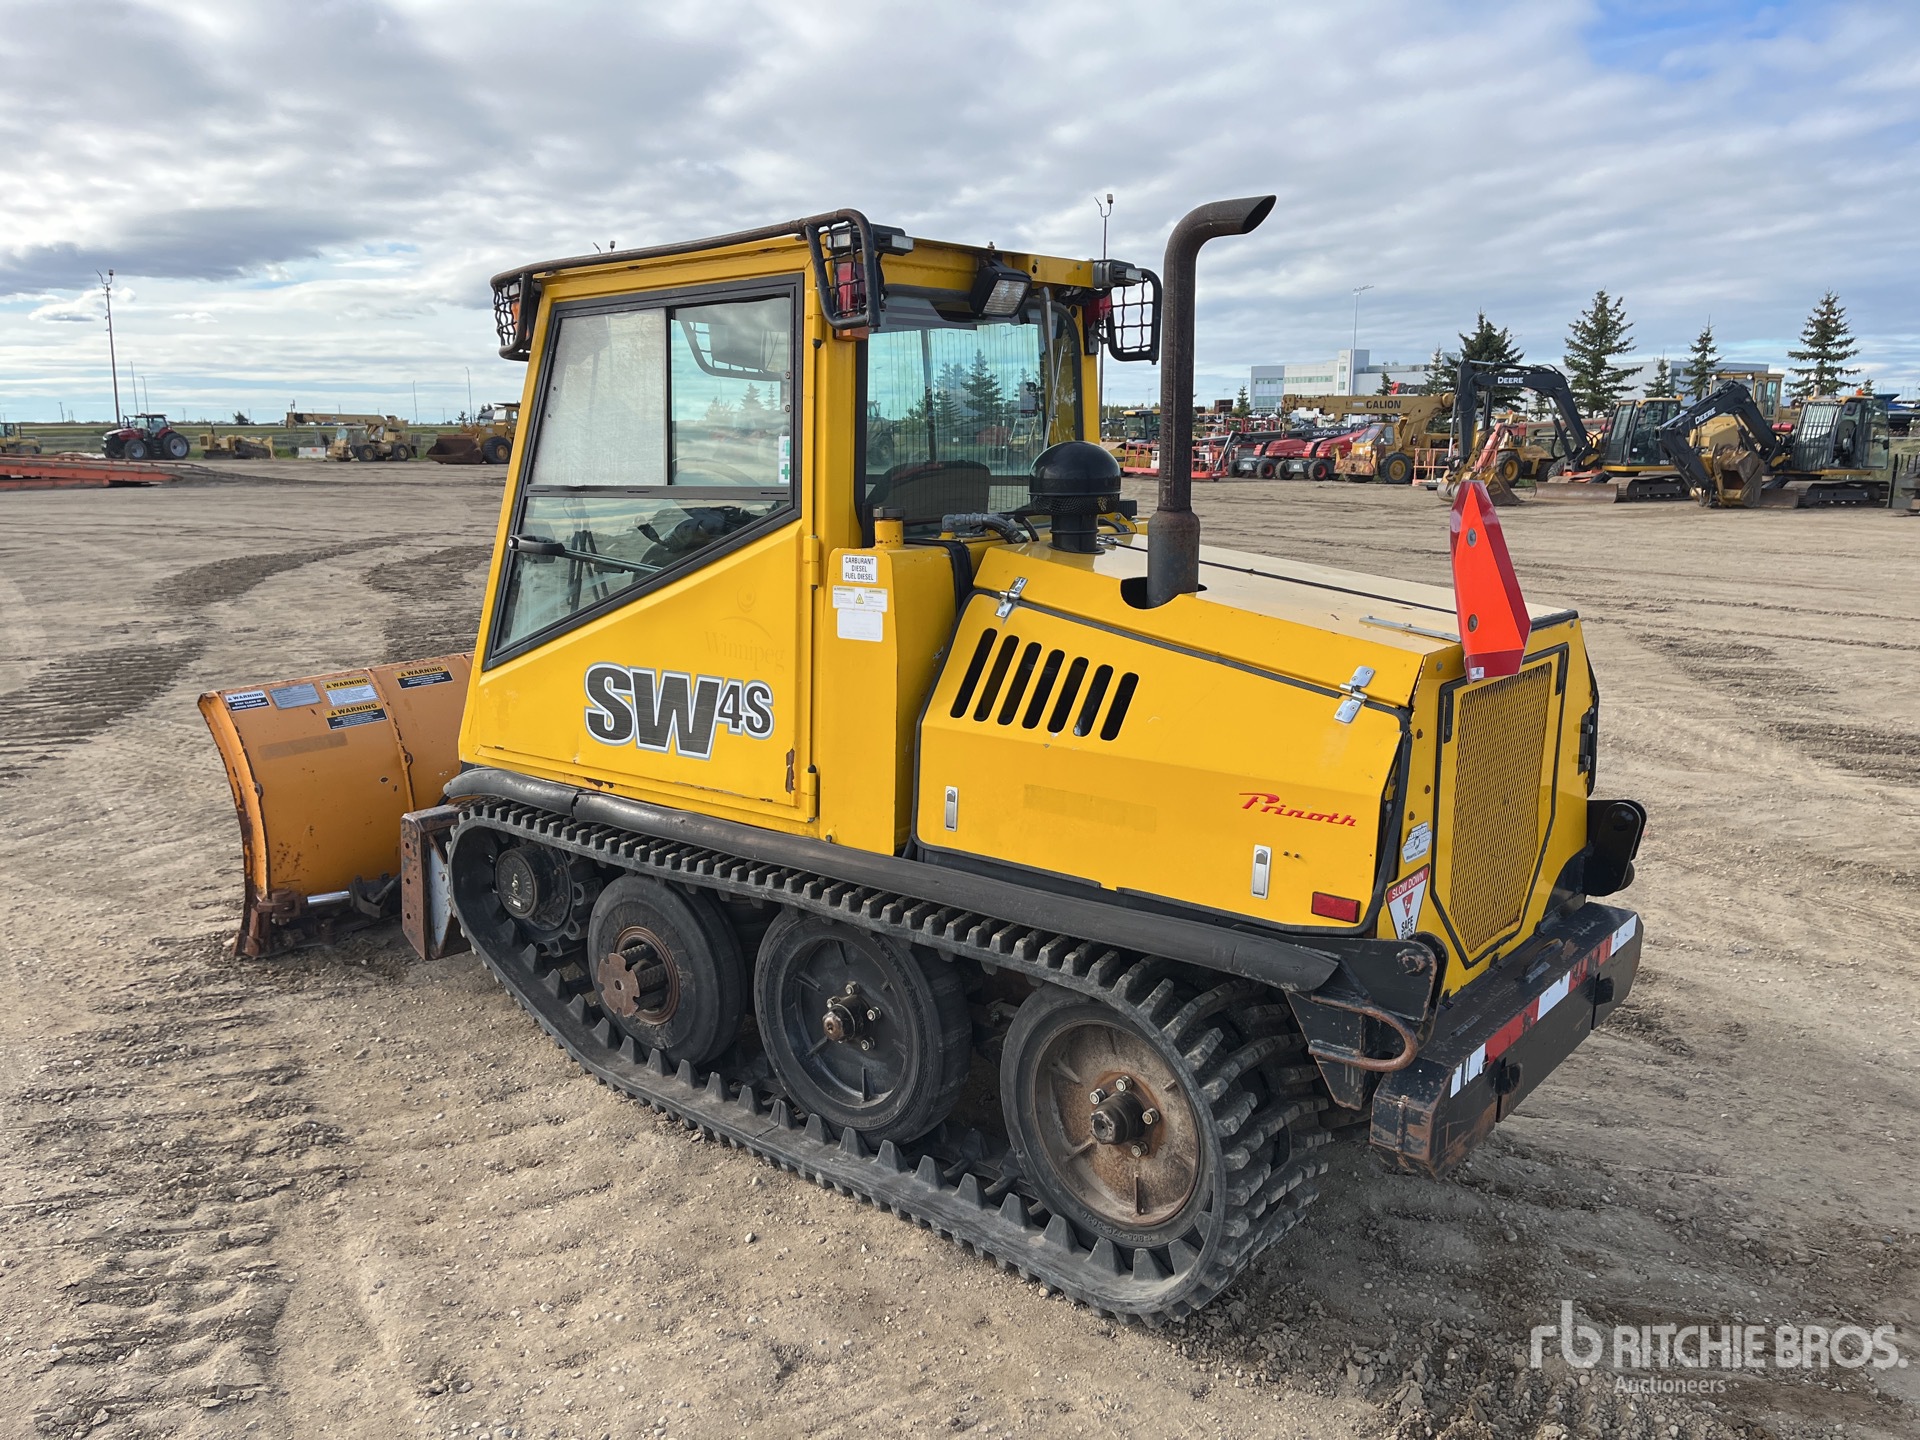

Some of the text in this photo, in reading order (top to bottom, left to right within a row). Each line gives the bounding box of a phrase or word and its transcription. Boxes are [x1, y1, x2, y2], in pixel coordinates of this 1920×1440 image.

[1497, 376, 1524, 384] DEERE
[1366, 400, 1402, 409] GALION
[1694, 407, 1716, 424] DEERE
[1312, 429, 1339, 437] SKYJACK
[844, 556, 874, 565] CARBURANT
[851, 565, 867, 573] DIESEL
[845, 572, 874, 581] FUEL DIESEL
[406, 666, 443, 676] WARNING
[332, 678, 368, 688] WARNING
[232, 692, 264, 700] WARNING
[337, 703, 378, 715] WARNING
[1239, 792, 1357, 827] Prinoth
[1391, 870, 1425, 899] SLOW DOWN
[1401, 915, 1414, 932] SAFE
